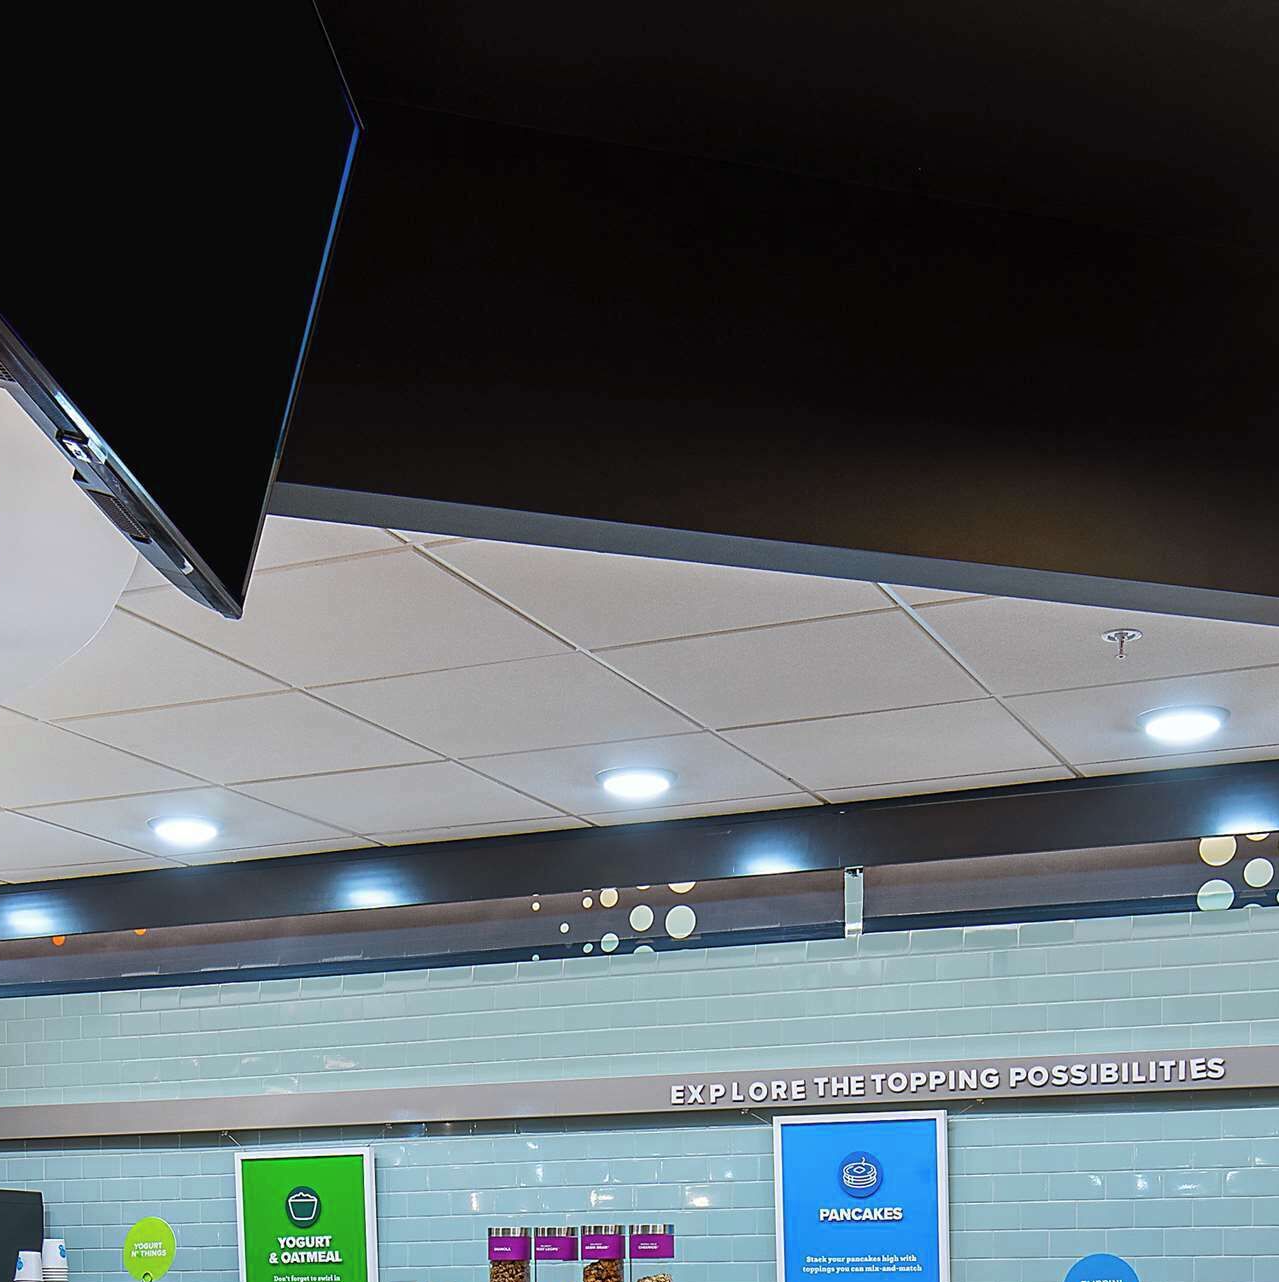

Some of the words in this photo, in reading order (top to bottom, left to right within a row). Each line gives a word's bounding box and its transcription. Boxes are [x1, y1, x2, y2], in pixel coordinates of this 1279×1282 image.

[671, 1079, 807, 1105] EXPLORE
[814, 1075, 866, 1099] THE
[871, 1068, 1000, 1095] TOPPING
[1009, 1058, 1226, 1088] POSSIBILITIES
[819, 1207, 904, 1222] PANCAKES
[133, 1242, 162, 1250] YOGURT
[278, 1235, 332, 1249] YOGURT
[140, 1249, 167, 1257] THINGS
[268, 1252, 279, 1264] &
[281, 1251, 343, 1264] OATMEAL
[806, 1255, 827, 1263] Stack
[846, 1255, 881, 1263] pancakes
[882, 1254, 899, 1263] high
[900, 1254, 917, 1262] with
[802, 1266, 835, 1274] toppings
[291, 1275, 310, 1282] forget
